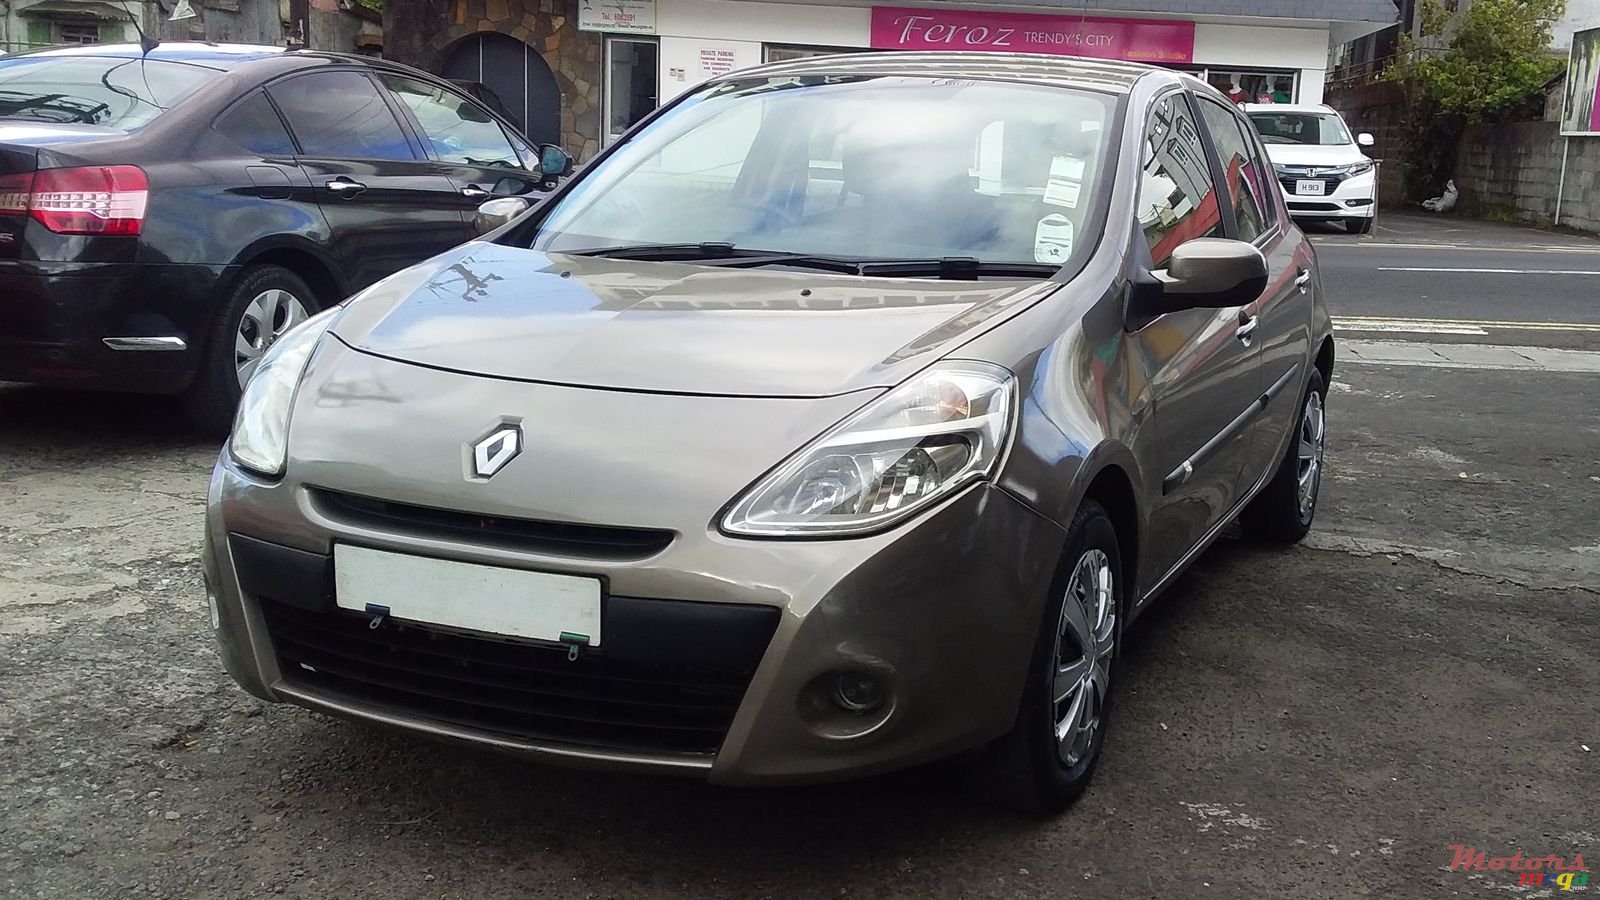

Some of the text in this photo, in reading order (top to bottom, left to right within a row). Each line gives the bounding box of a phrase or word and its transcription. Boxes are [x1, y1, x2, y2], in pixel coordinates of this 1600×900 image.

[894, 15, 1015, 46] Feroz
[1024, 31, 1114, 46] TRENDY'S CITY
